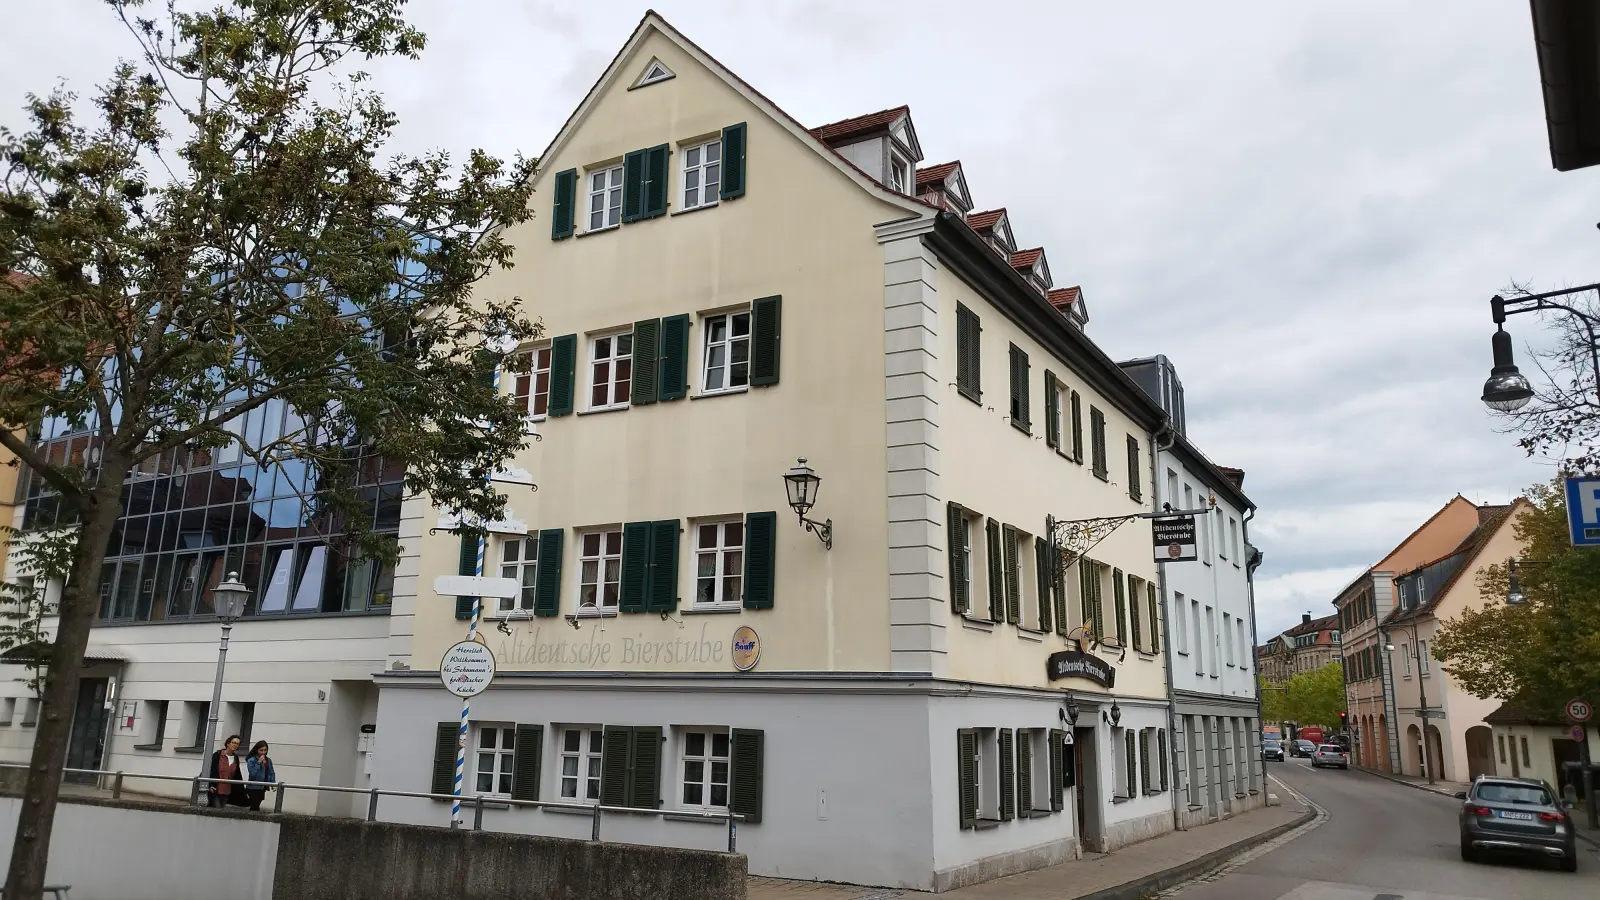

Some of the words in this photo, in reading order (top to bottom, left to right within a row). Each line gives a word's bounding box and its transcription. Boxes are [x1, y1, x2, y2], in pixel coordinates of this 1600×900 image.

[1153, 523, 1194, 532] Altdeutsche
[1156, 532, 1191, 540] Bierstube
[496, 624, 611, 668] Altdeutsche
[620, 622, 723, 663] Bierstube
[1058, 658, 1084, 674] Altdeutsche
[1572, 705, 1586, 716] 50
